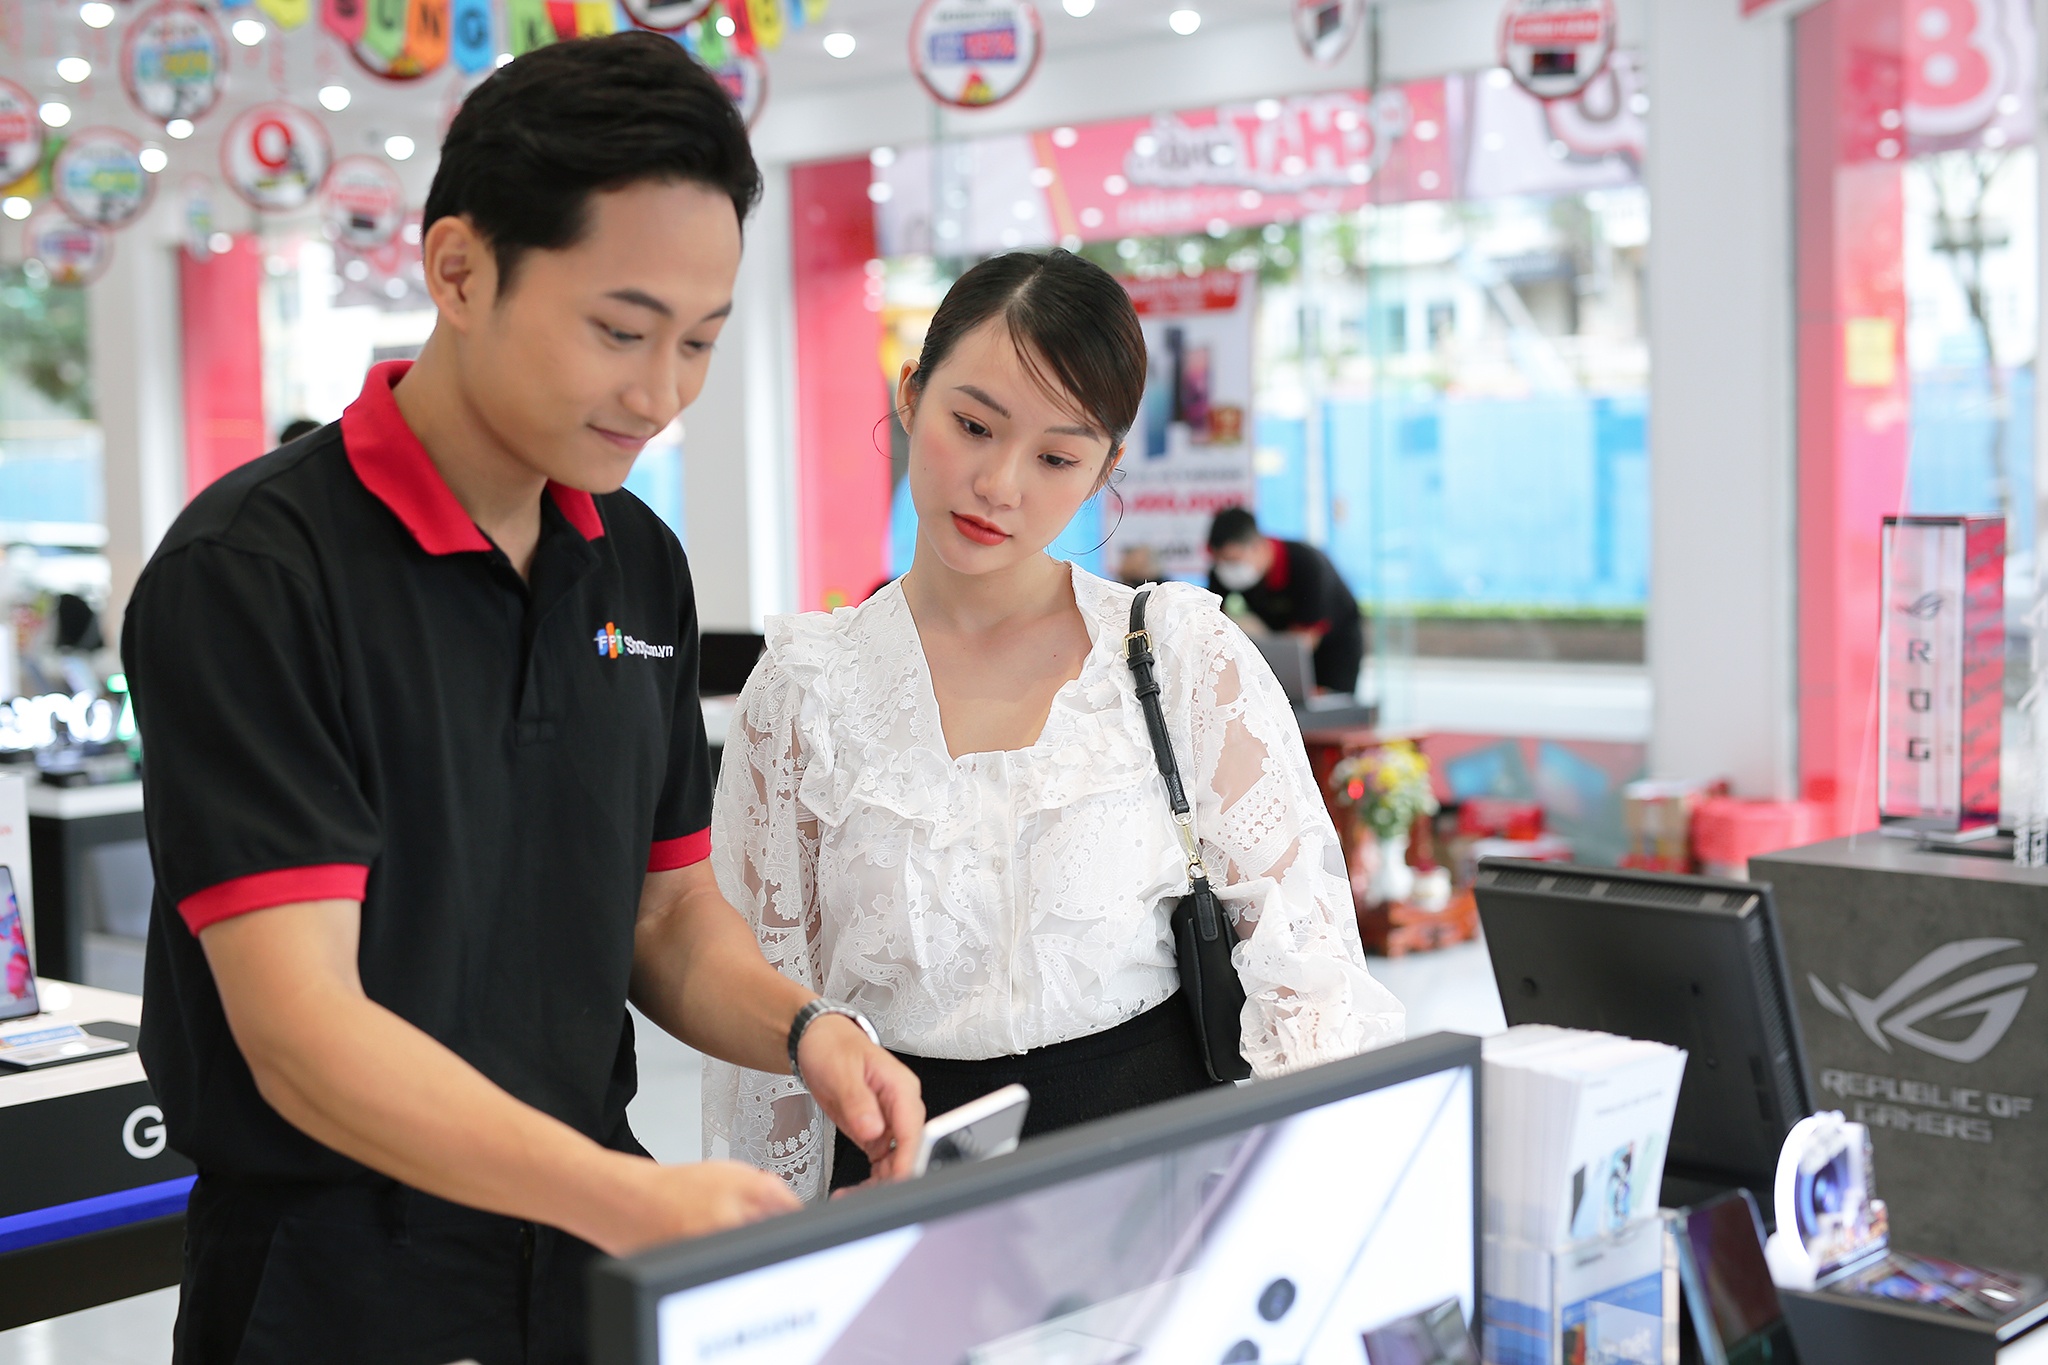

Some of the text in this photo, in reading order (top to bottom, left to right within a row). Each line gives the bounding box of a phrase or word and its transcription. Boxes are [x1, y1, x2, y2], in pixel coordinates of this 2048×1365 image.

[1908, 637, 1933, 763] ROG
[1820, 1068, 2033, 1119] REPUBLIC OF
[1854, 1101, 1993, 1144] GAMERS
